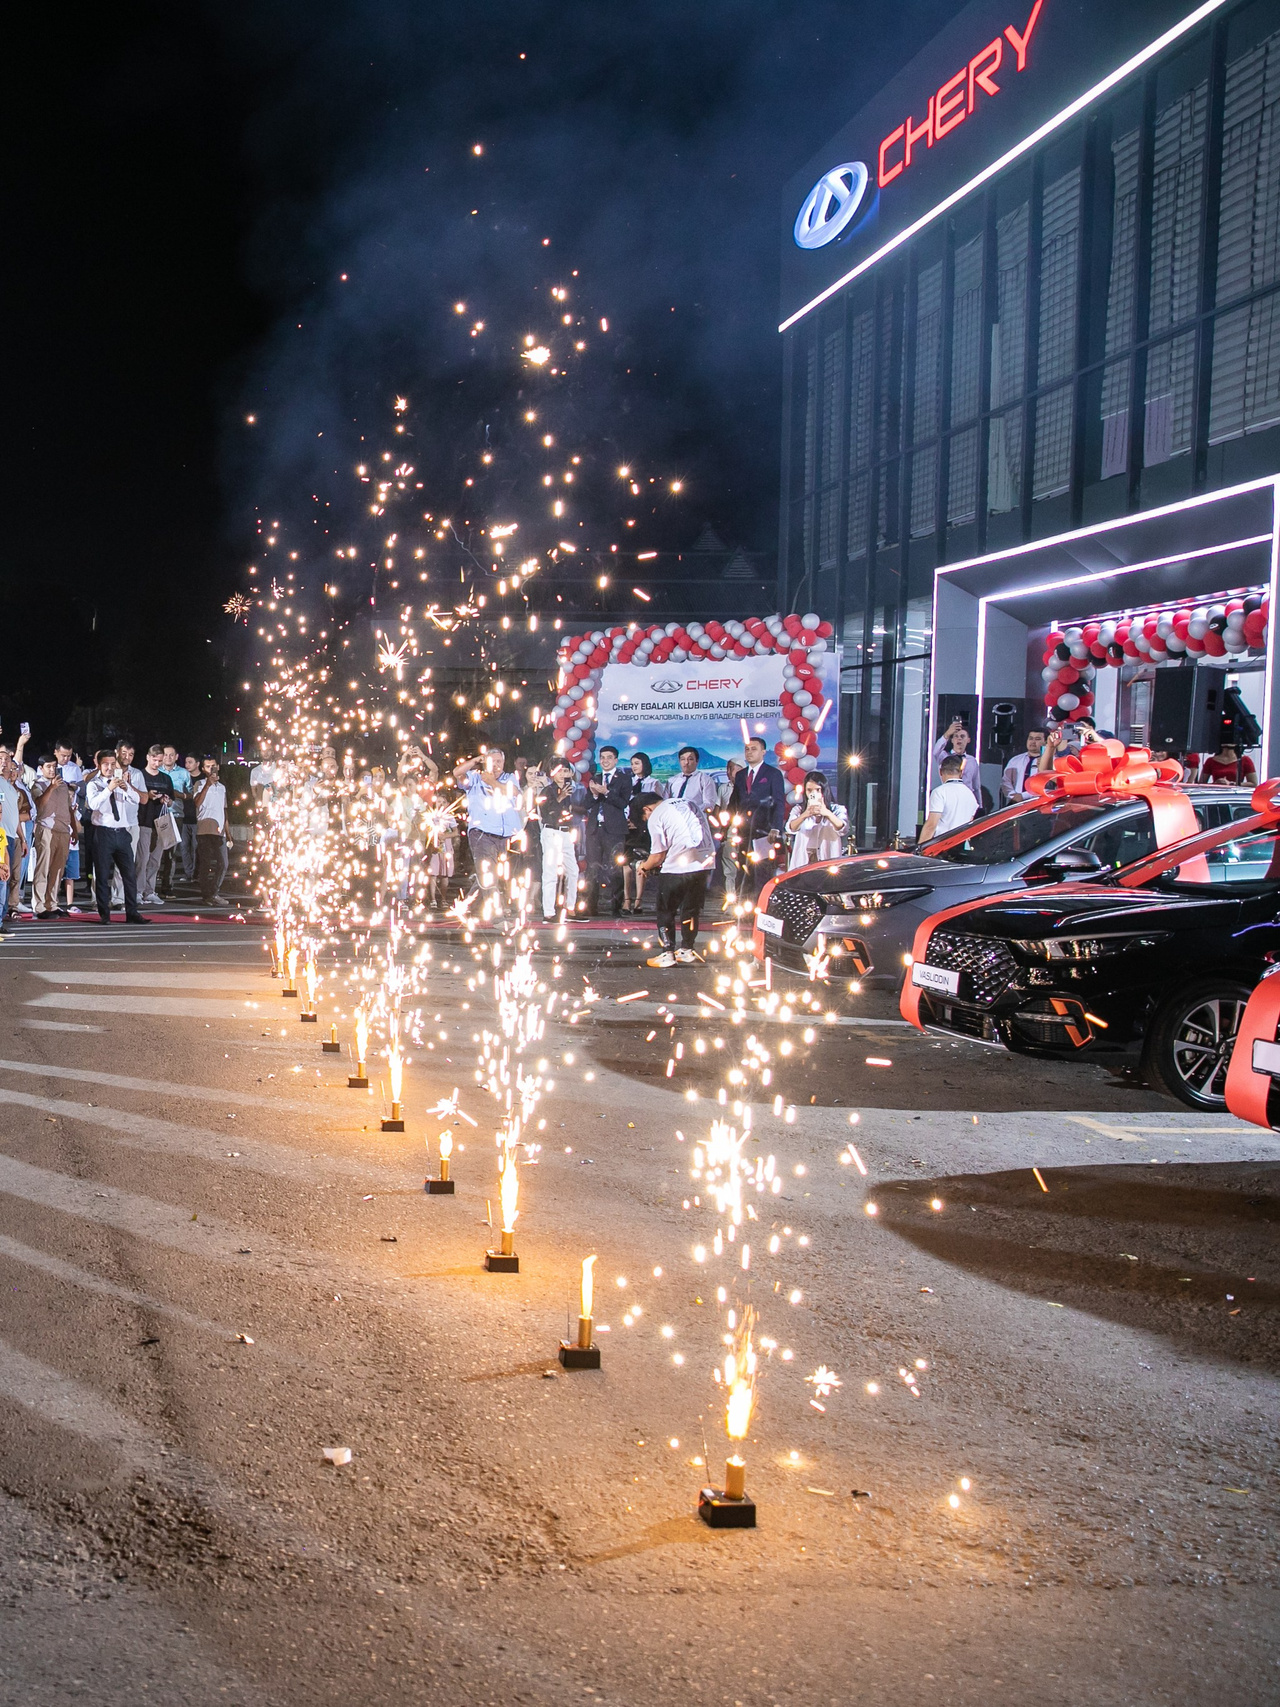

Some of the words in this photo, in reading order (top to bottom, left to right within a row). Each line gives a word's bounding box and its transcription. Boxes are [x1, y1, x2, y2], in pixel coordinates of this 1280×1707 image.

[877, 0, 1044, 188] CHERY
[686, 678, 743, 691] CHERY
[612, 703, 639, 711] CHERY
[640, 702, 676, 711] EGALARI
[677, 701, 715, 710] KLUBIGA
[716, 701, 742, 709] XUSH
[708, 712, 755, 720] ВЛАДЕЛЬЦЕВ
